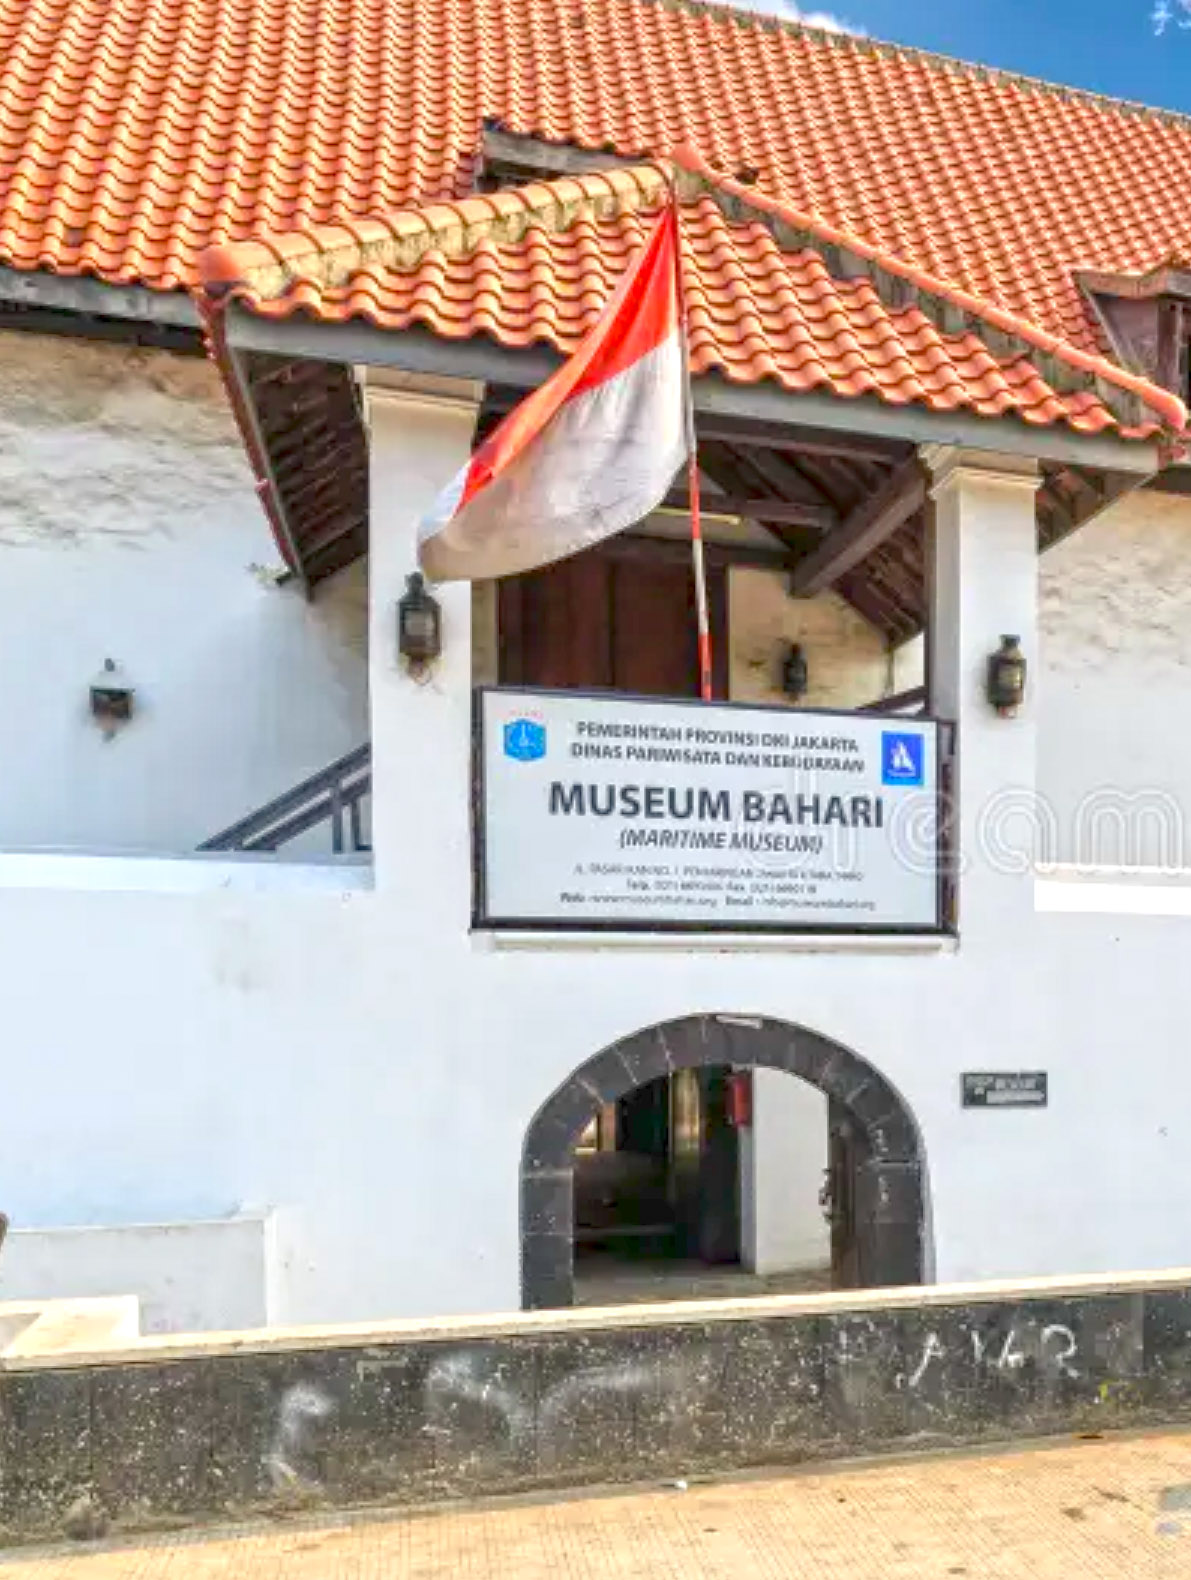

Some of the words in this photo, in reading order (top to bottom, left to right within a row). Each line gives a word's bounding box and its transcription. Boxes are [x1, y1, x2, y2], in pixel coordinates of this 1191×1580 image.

[576, 721, 682, 741] PEMERINTAH
[685, 727, 759, 746] PROVINSI
[761, 733, 789, 748] DKI
[791, 735, 859, 752] JAKARTA
[570, 742, 622, 760] DINAS
[626, 745, 721, 765] PARIWISATA
[725, 751, 760, 767] DAN
[549, 781, 731, 822] MUSEUM
[743, 789, 884, 828] BAHARI
[620, 828, 727, 850] (MARITIME
[728, 832, 824, 854] MUSEUM)
